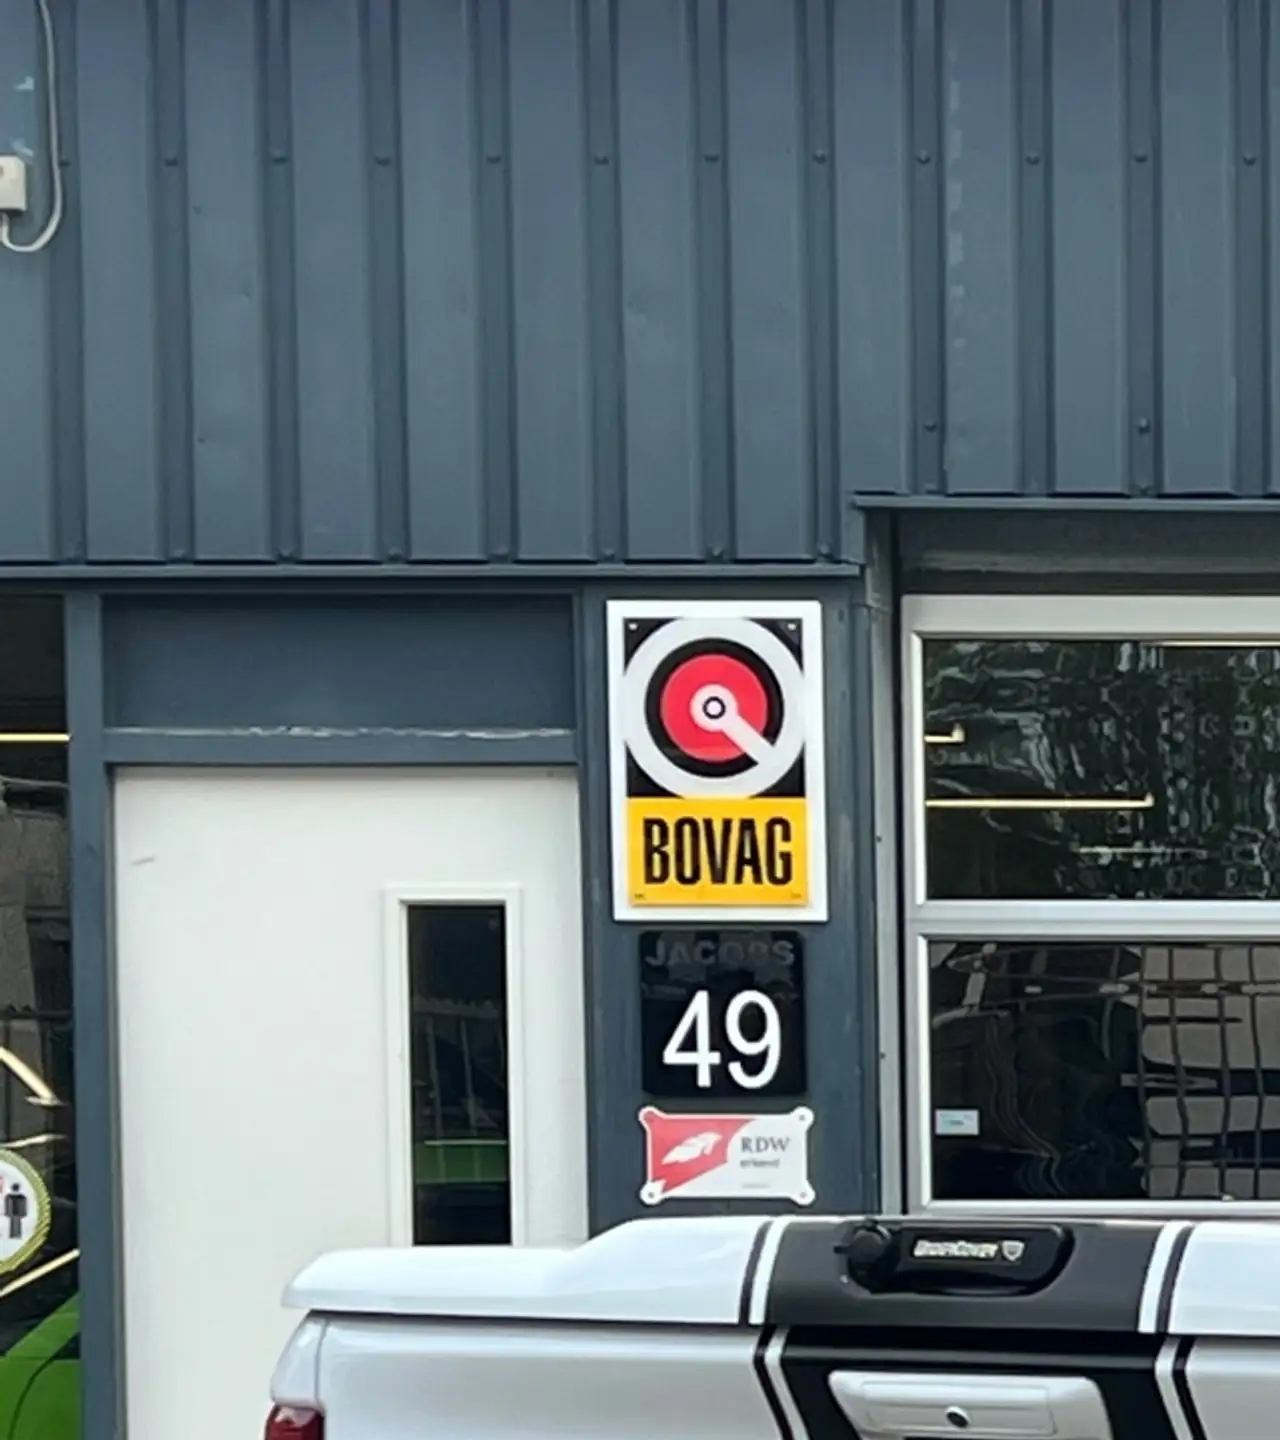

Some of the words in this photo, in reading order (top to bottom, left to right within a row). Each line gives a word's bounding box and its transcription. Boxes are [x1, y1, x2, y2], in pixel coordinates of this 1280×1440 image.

[642, 816, 794, 886] BOVAG
[661, 988, 783, 1090] 49
[740, 1135, 791, 1153] RDW
